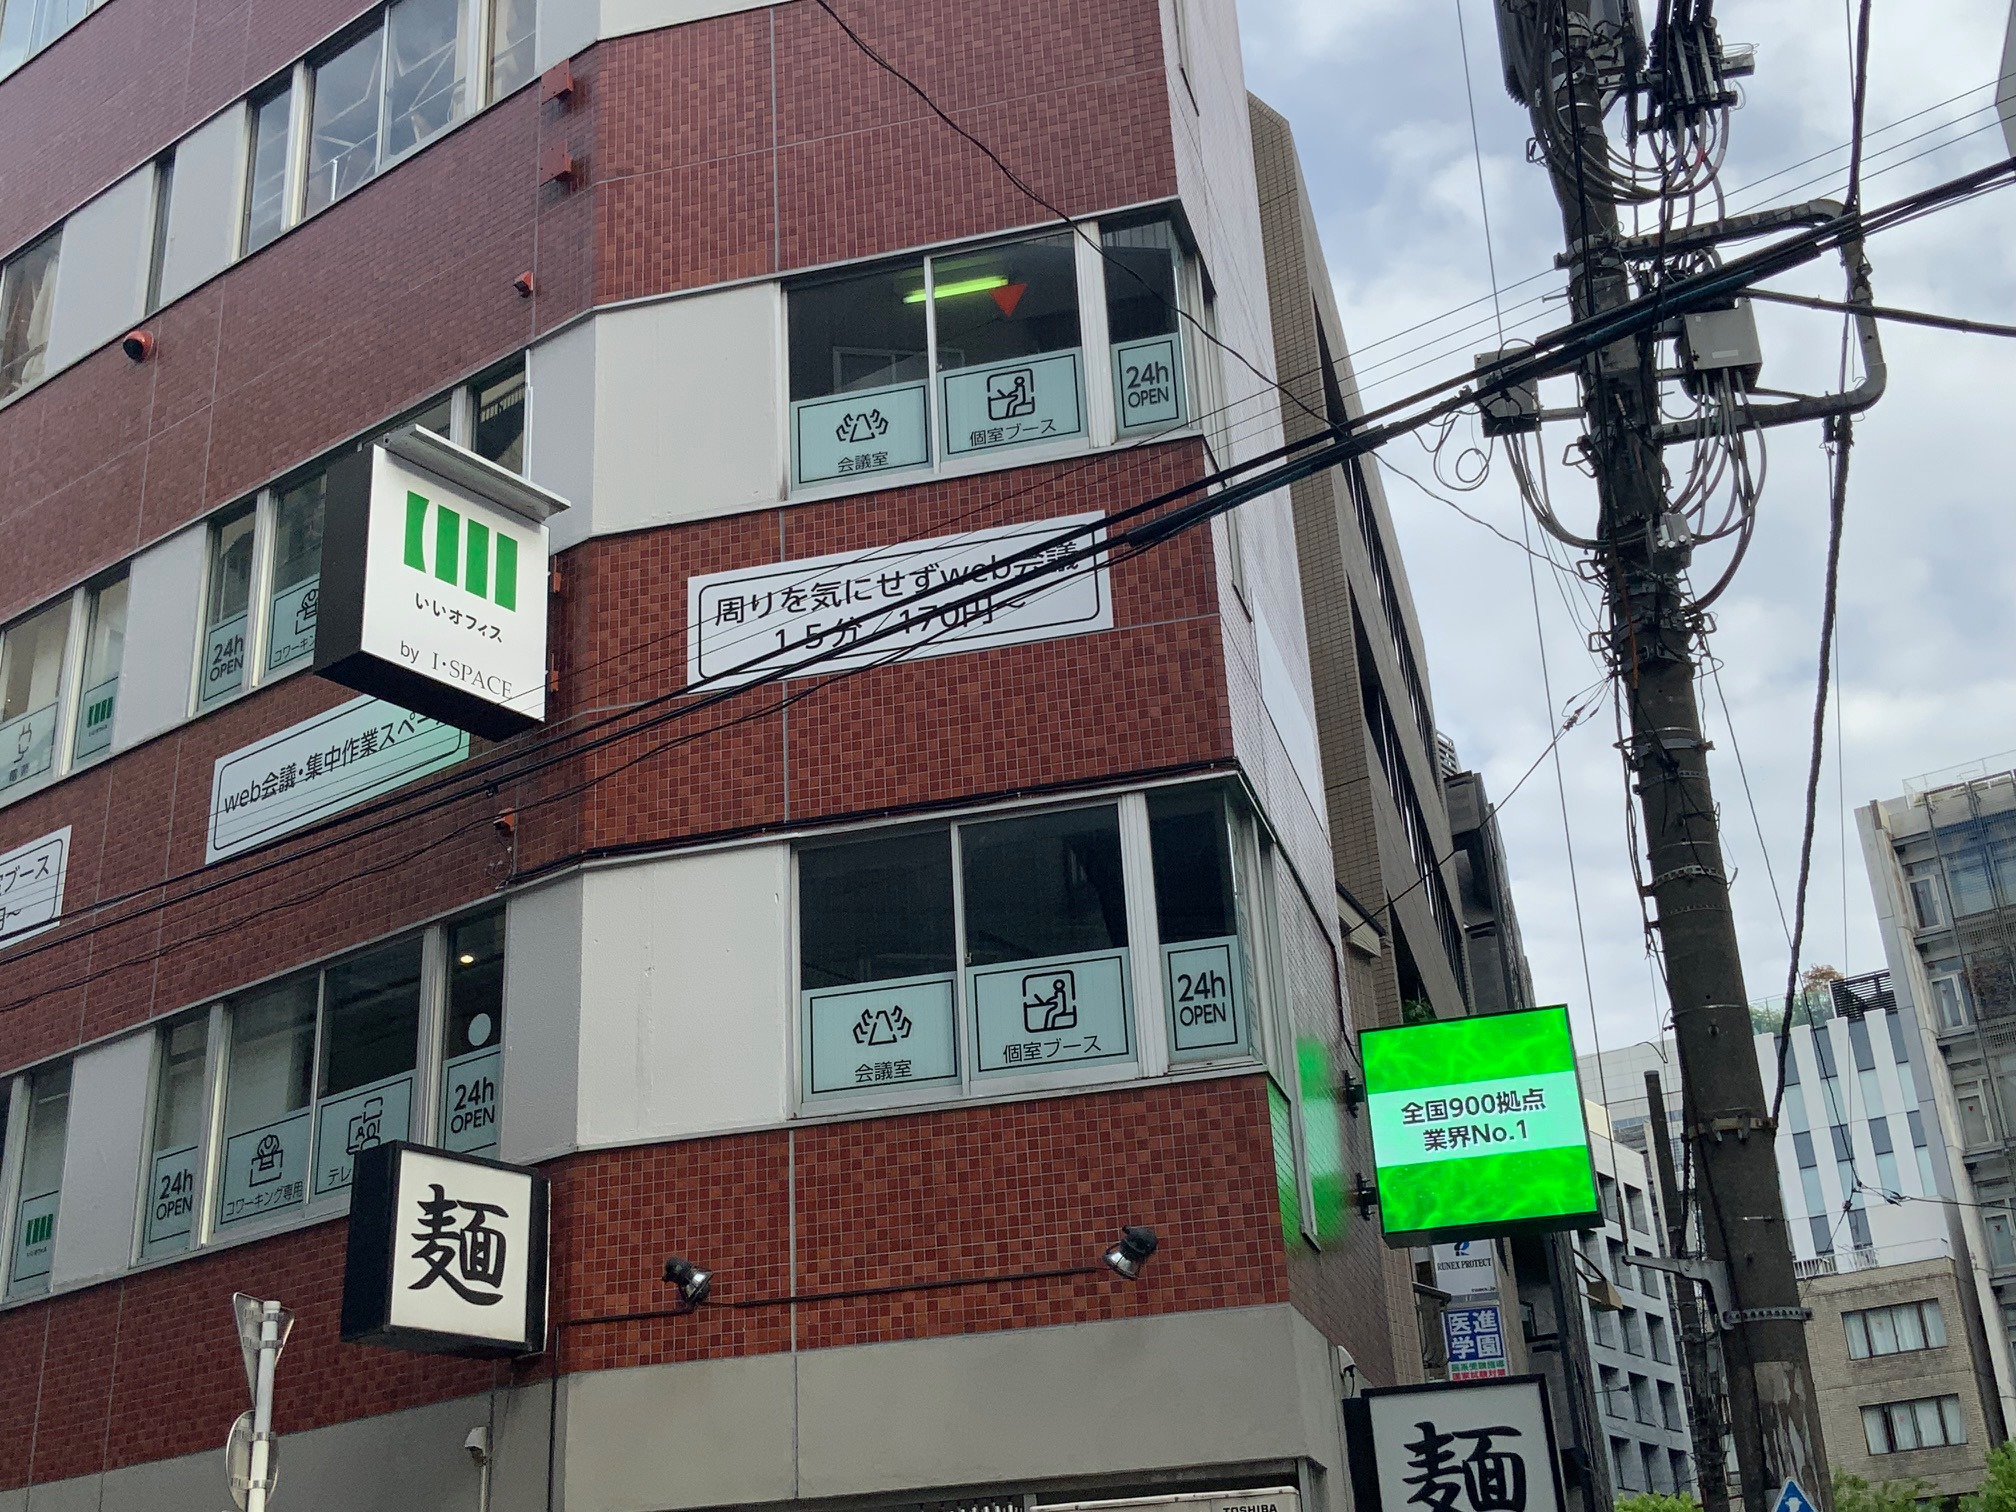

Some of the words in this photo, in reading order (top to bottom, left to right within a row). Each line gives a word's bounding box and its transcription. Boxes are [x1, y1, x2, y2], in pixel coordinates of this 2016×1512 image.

[1126, 361, 1169, 390] 24h
[1128, 386, 1169, 408] OPEN
[970, 418, 1056, 447] 個室ブース
[838, 451, 888, 473] 会議室
[415, 592, 502, 643] いいオフィス
[212, 634, 244, 666] 24h
[400, 640, 420, 664] by
[209, 654, 244, 682] OPEN
[224, 710, 441, 813] web会議・集中作業スペー
[0, 855, 49, 894] ブース
[1177, 969, 1226, 1002] 24h
[1180, 1002, 1226, 1027] OPEN
[1002, 1034, 1102, 1064] 個室ブース
[854, 1059, 912, 1083] 会議室
[454, 1076, 494, 1111] 24h
[1401, 1088, 1546, 1125] 全国900拠点
[451, 1105, 495, 1133] OPEN
[1423, 1119, 1528, 1151] 業界No.1
[159, 1168, 193, 1199] 24h
[156, 1194, 192, 1220] OPEN
[226, 1181, 303, 1216] コワーキング専用
[407, 1183, 509, 1306] 麺
[1437, 1261, 1460, 1271] RUNEX
[1461, 1258, 1491, 1269] PROTECT
[1449, 1309, 1498, 1336] 医進
[1452, 1333, 1502, 1360] 学園
[1402, 1421, 1527, 1512] 麺
